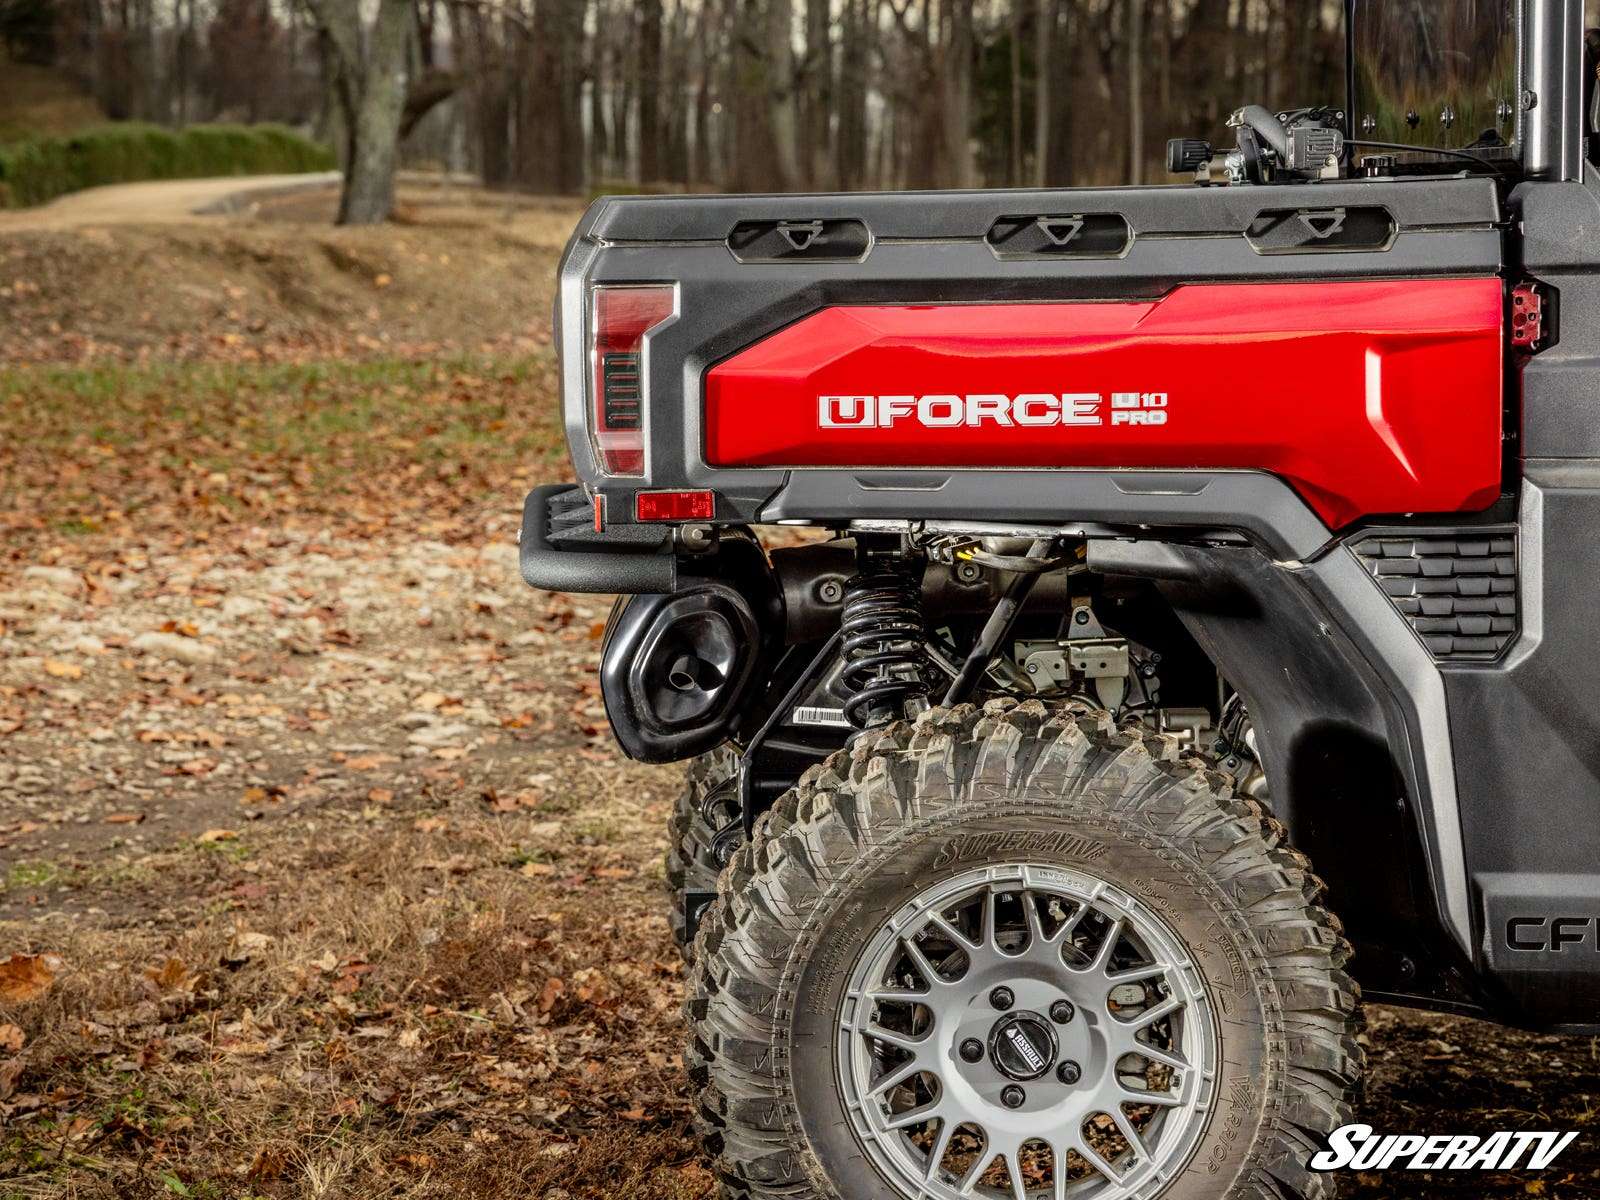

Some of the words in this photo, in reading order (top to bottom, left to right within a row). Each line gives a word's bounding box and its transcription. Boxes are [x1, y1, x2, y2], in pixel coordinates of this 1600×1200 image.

[1111, 392, 1168, 408] U10
[1111, 410, 1168, 426] PRO
[1506, 916, 1600, 952] CF
[1217, 934, 1246, 983] DIRECTION
[1014, 1033, 1045, 1069] ASSAULT
